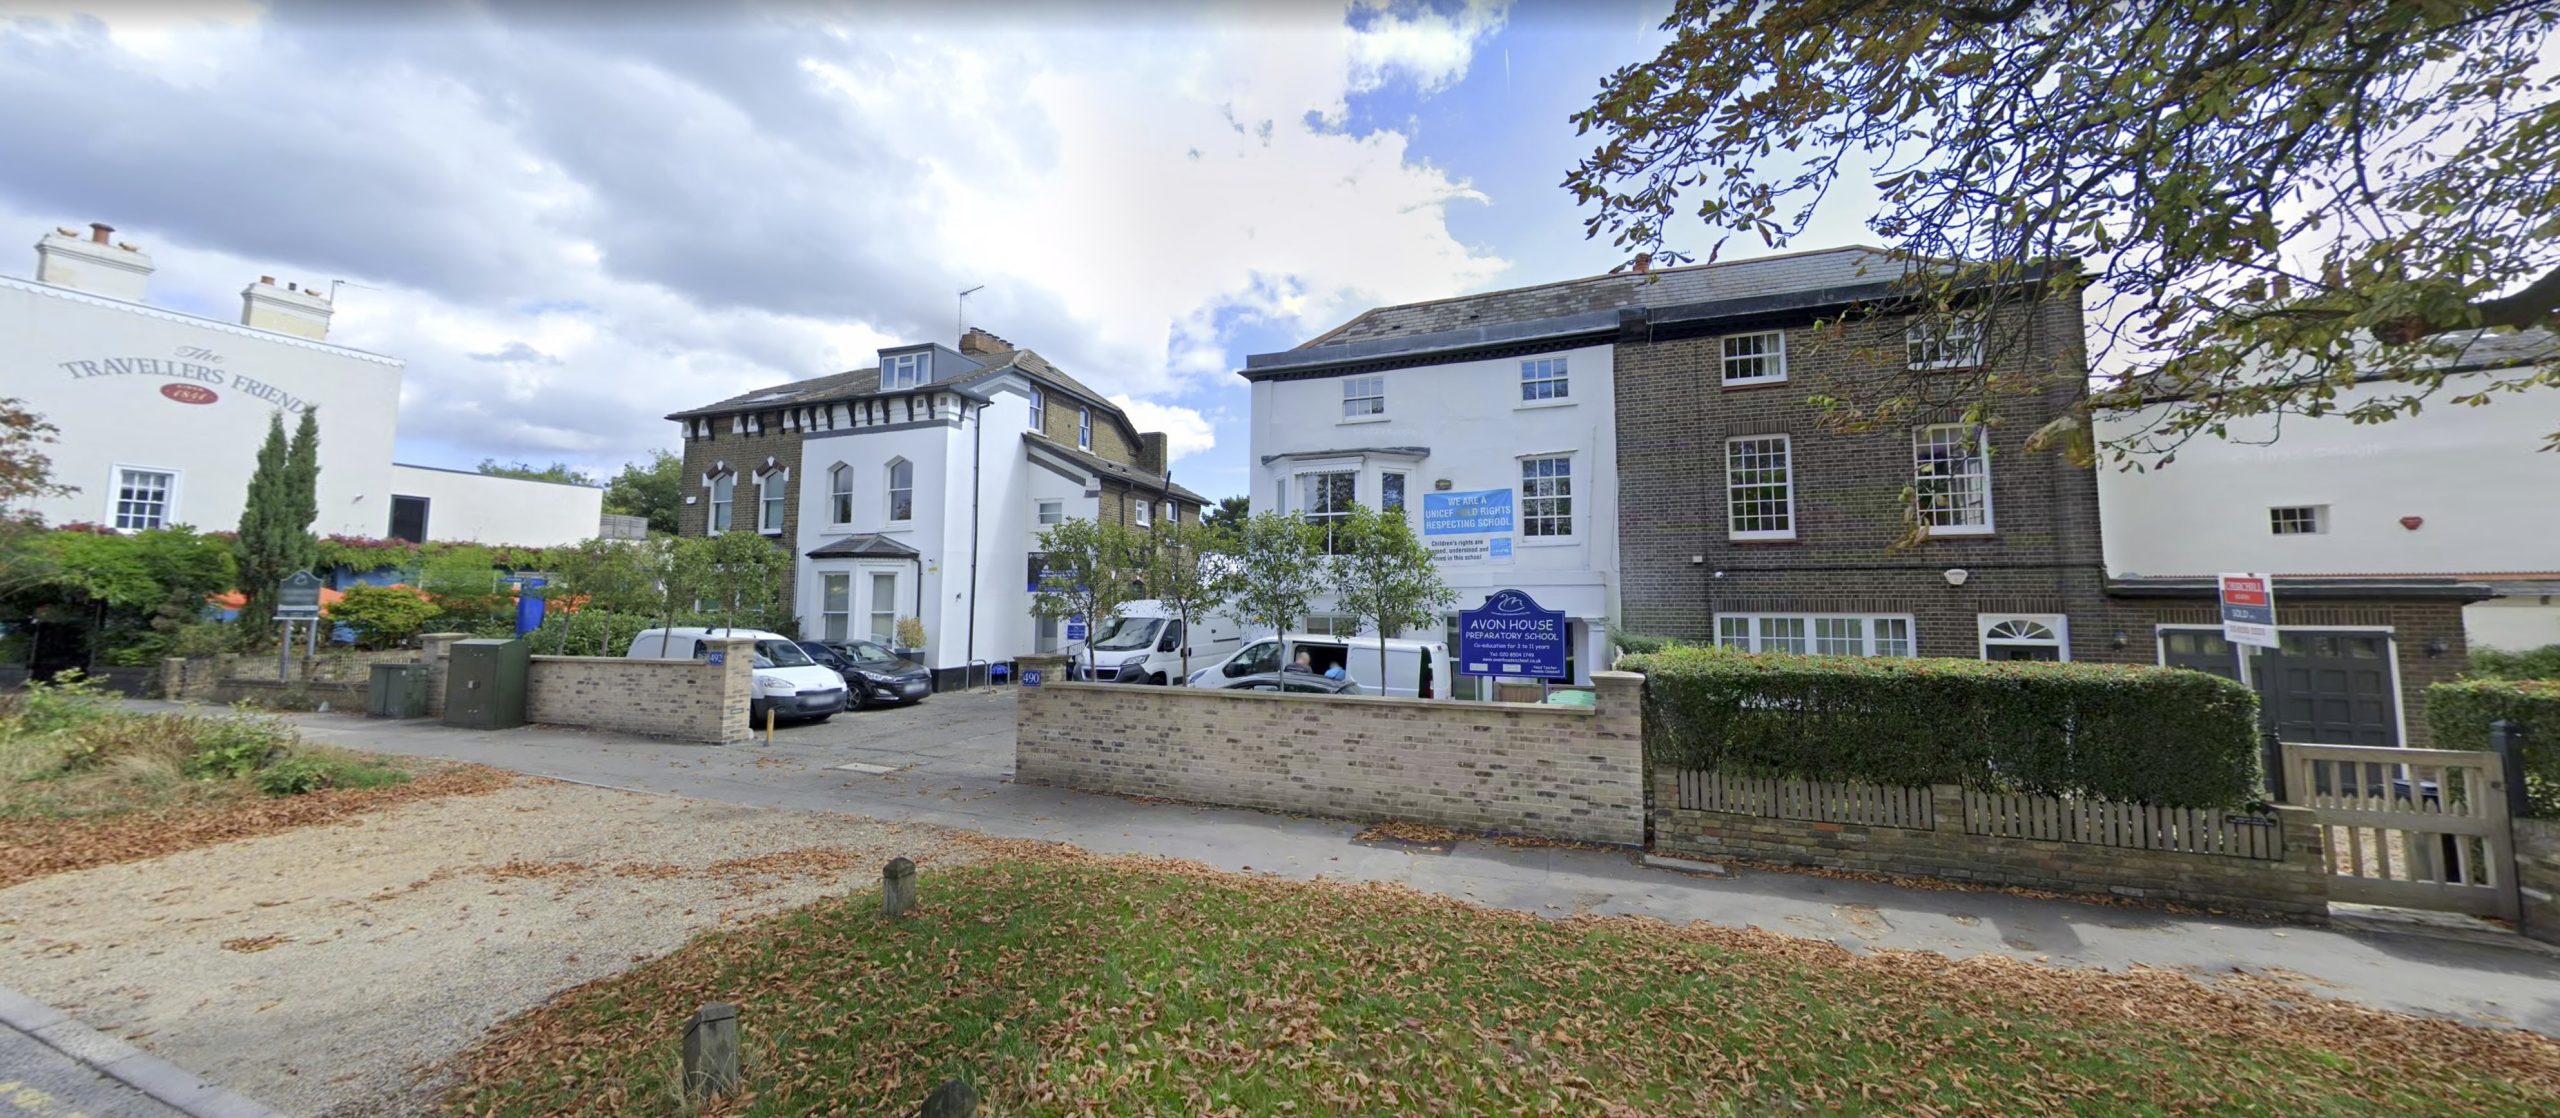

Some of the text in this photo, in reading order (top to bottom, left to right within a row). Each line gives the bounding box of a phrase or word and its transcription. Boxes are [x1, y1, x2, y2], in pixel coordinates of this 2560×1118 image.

[174, 346, 224, 364] The
[58, 358, 307, 414] TRAVELLERS FRIEND
[1448, 495, 1488, 506] WE ARE A
[1425, 508, 1454, 519] UNICEF
[1480, 505, 1511, 516] RIGHTS
[1426, 517, 1511, 529] RESPECTING SCHOOL
[1459, 539, 1474, 547] rights
[1470, 619, 1554, 631] AVON HOUSE
[1465, 631, 1559, 640] PREPARATORY SCHOOL
[710, 652, 723, 664] 492
[1023, 671, 1040, 684] 490
